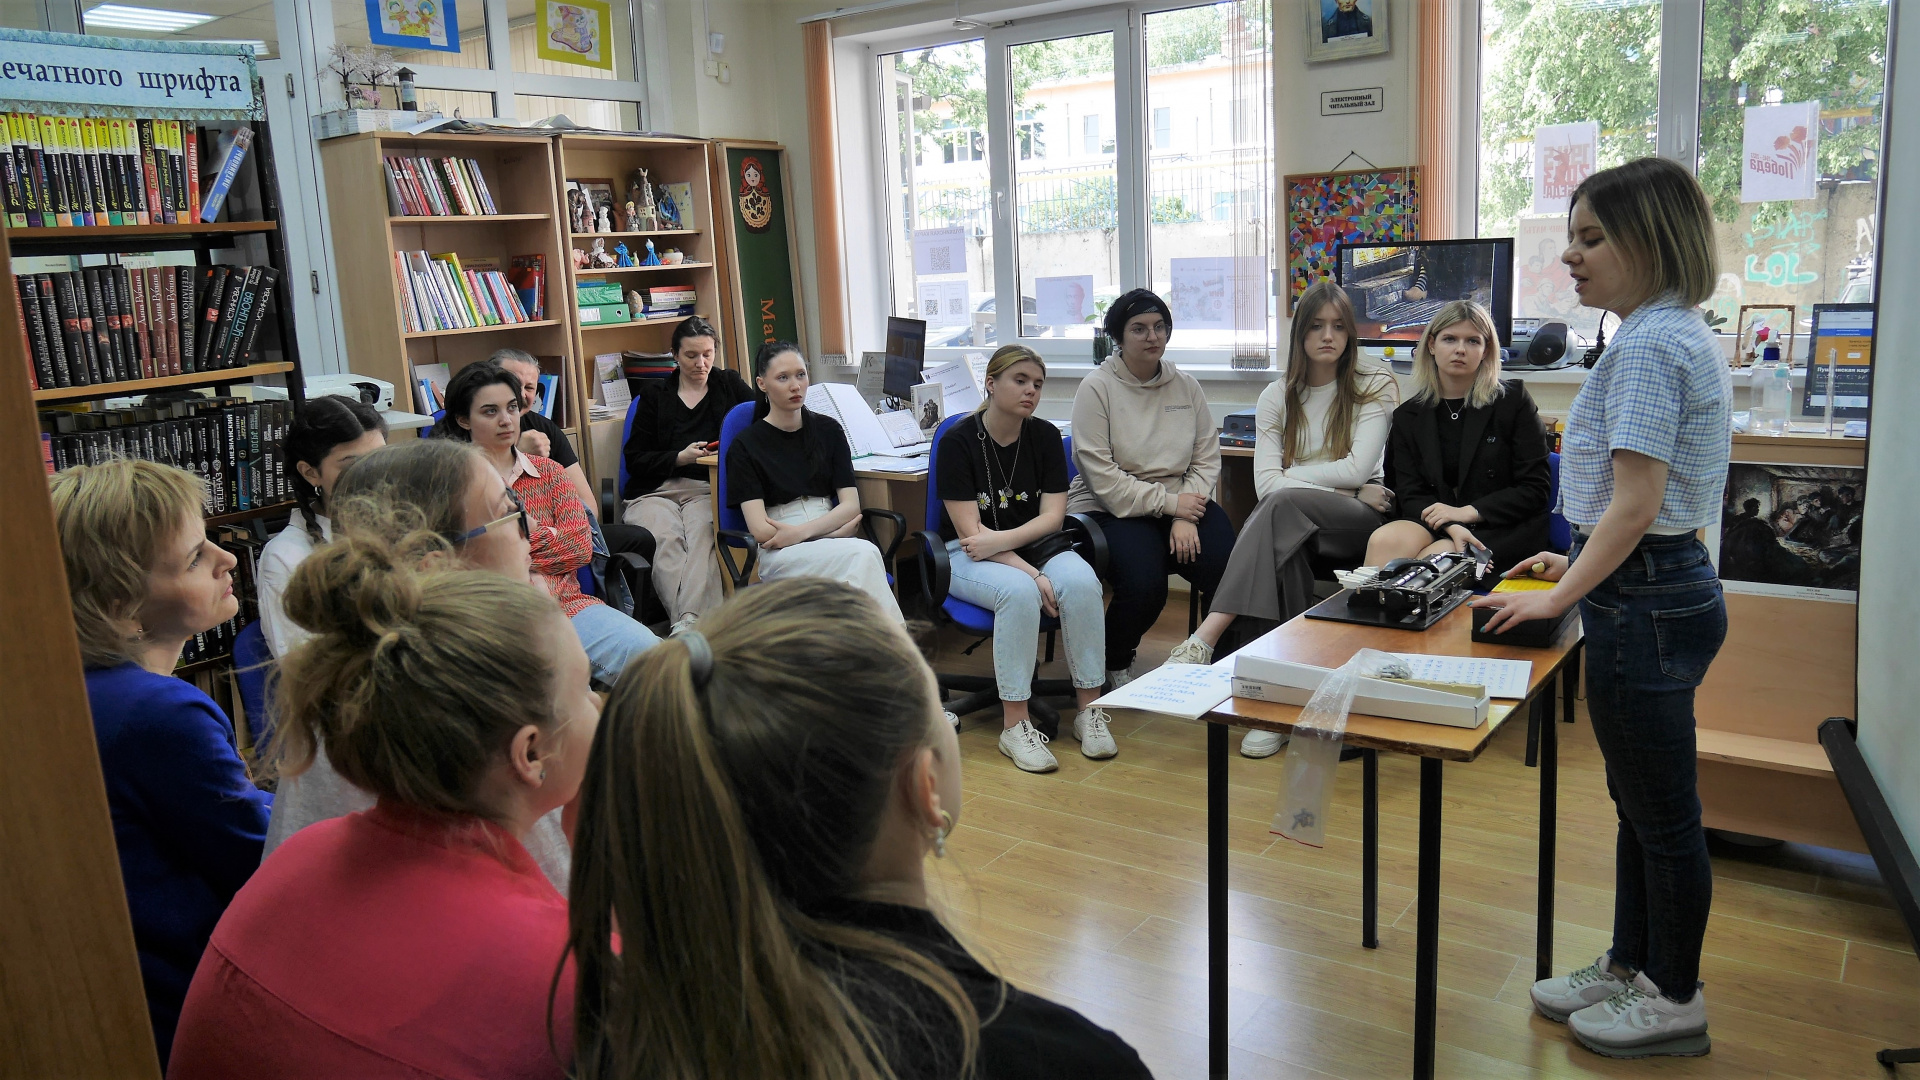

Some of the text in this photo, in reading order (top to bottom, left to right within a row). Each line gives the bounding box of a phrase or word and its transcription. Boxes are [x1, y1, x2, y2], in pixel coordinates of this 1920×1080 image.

[0, 61, 242, 99] ечатного шрифта
[1328, 101, 1364, 110] ЧИТАЛЬНЫЙ
[1330, 93, 1372, 103] ЭЛЕКТРОННЫЙ
[222, 150, 243, 188] ЛИТВИНОВЫ
[1745, 251, 1819, 288] LOL
[64, 280, 75, 314] Полякова
[79, 279, 88, 313] Полякова
[108, 277, 117, 310] Полякова
[134, 275, 143, 302] Рубина
[150, 274, 163, 324] Дина Рубина
[165, 274, 176, 324] Дина Рубина
[226, 287, 241, 322] УСТИНОВА
[256, 287, 271, 322] УСТИНОВА
[138, 305, 146, 325] Дина
[231, 292, 254, 337] УСТИНОВА
[760, 297, 776, 345] Mat
[226, 414, 235, 467] Ф.НЕЗНАНСКИЙ
[214, 472, 224, 512] СПЕЦНАЗ
[1129, 694, 1185, 704] БРАЙЛЮ
[1143, 685, 1196, 696] ПИСЬМА
[1157, 678, 1211, 688] ТЕТРАДЬ
